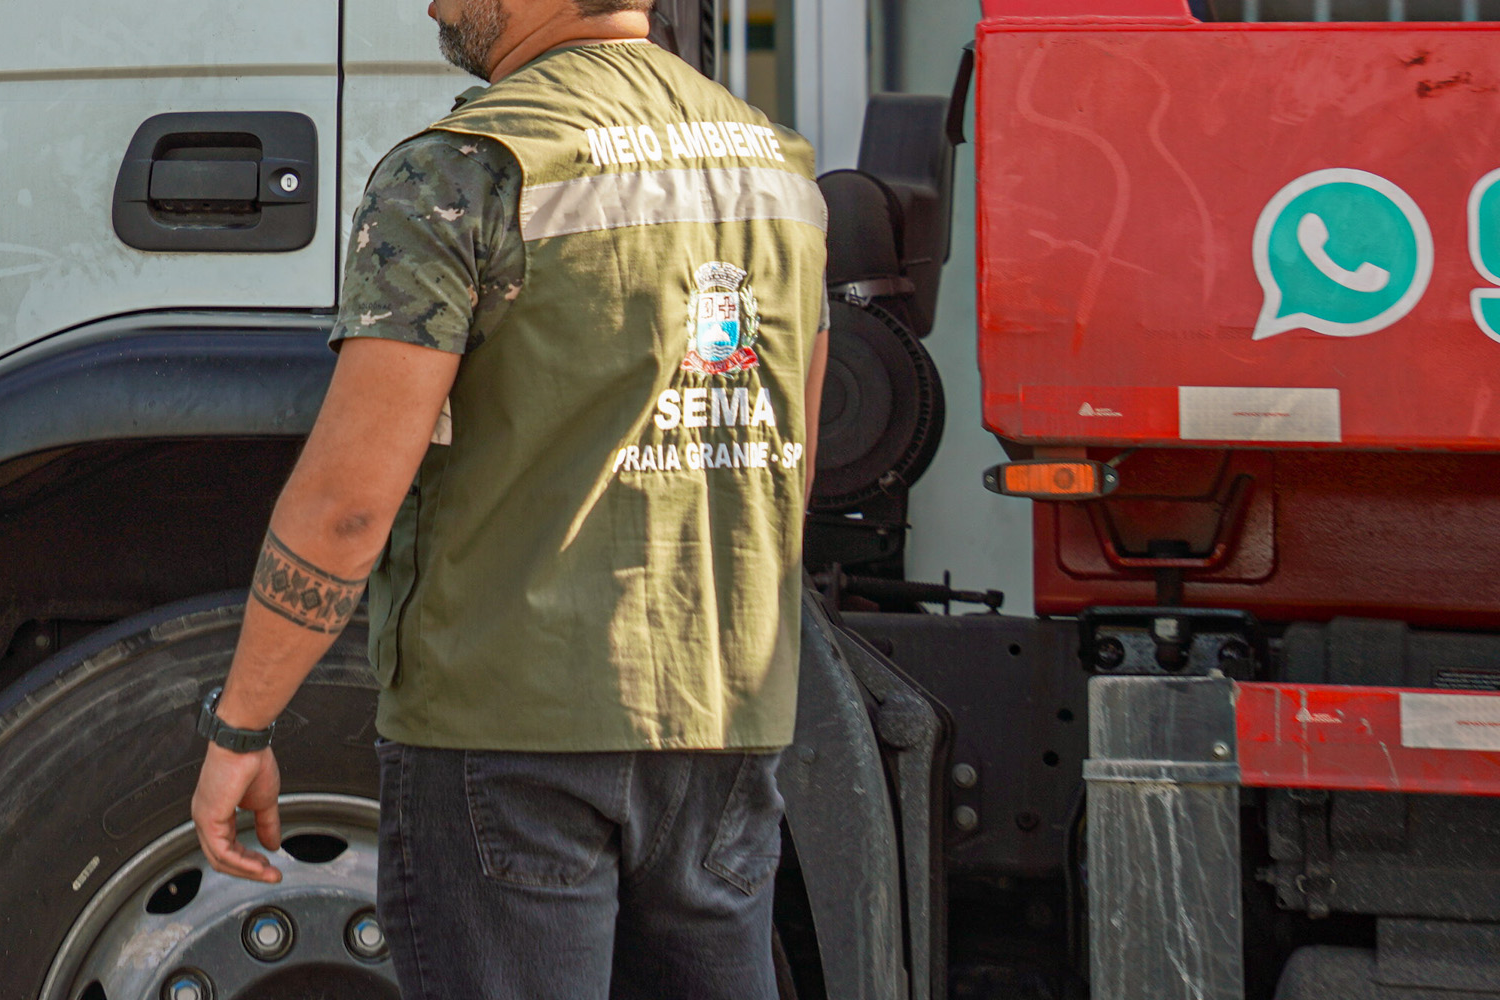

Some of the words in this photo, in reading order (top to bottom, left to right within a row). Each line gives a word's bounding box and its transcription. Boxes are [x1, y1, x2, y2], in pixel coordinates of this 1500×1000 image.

[585, 124, 663, 167] MEIO
[665, 121, 785, 162] AMBIENTE
[654, 387, 776, 430] SEMA
[612, 444, 682, 473] PRAIA
[685, 441, 769, 470] GRANDE
[782, 442, 803, 469] SP
